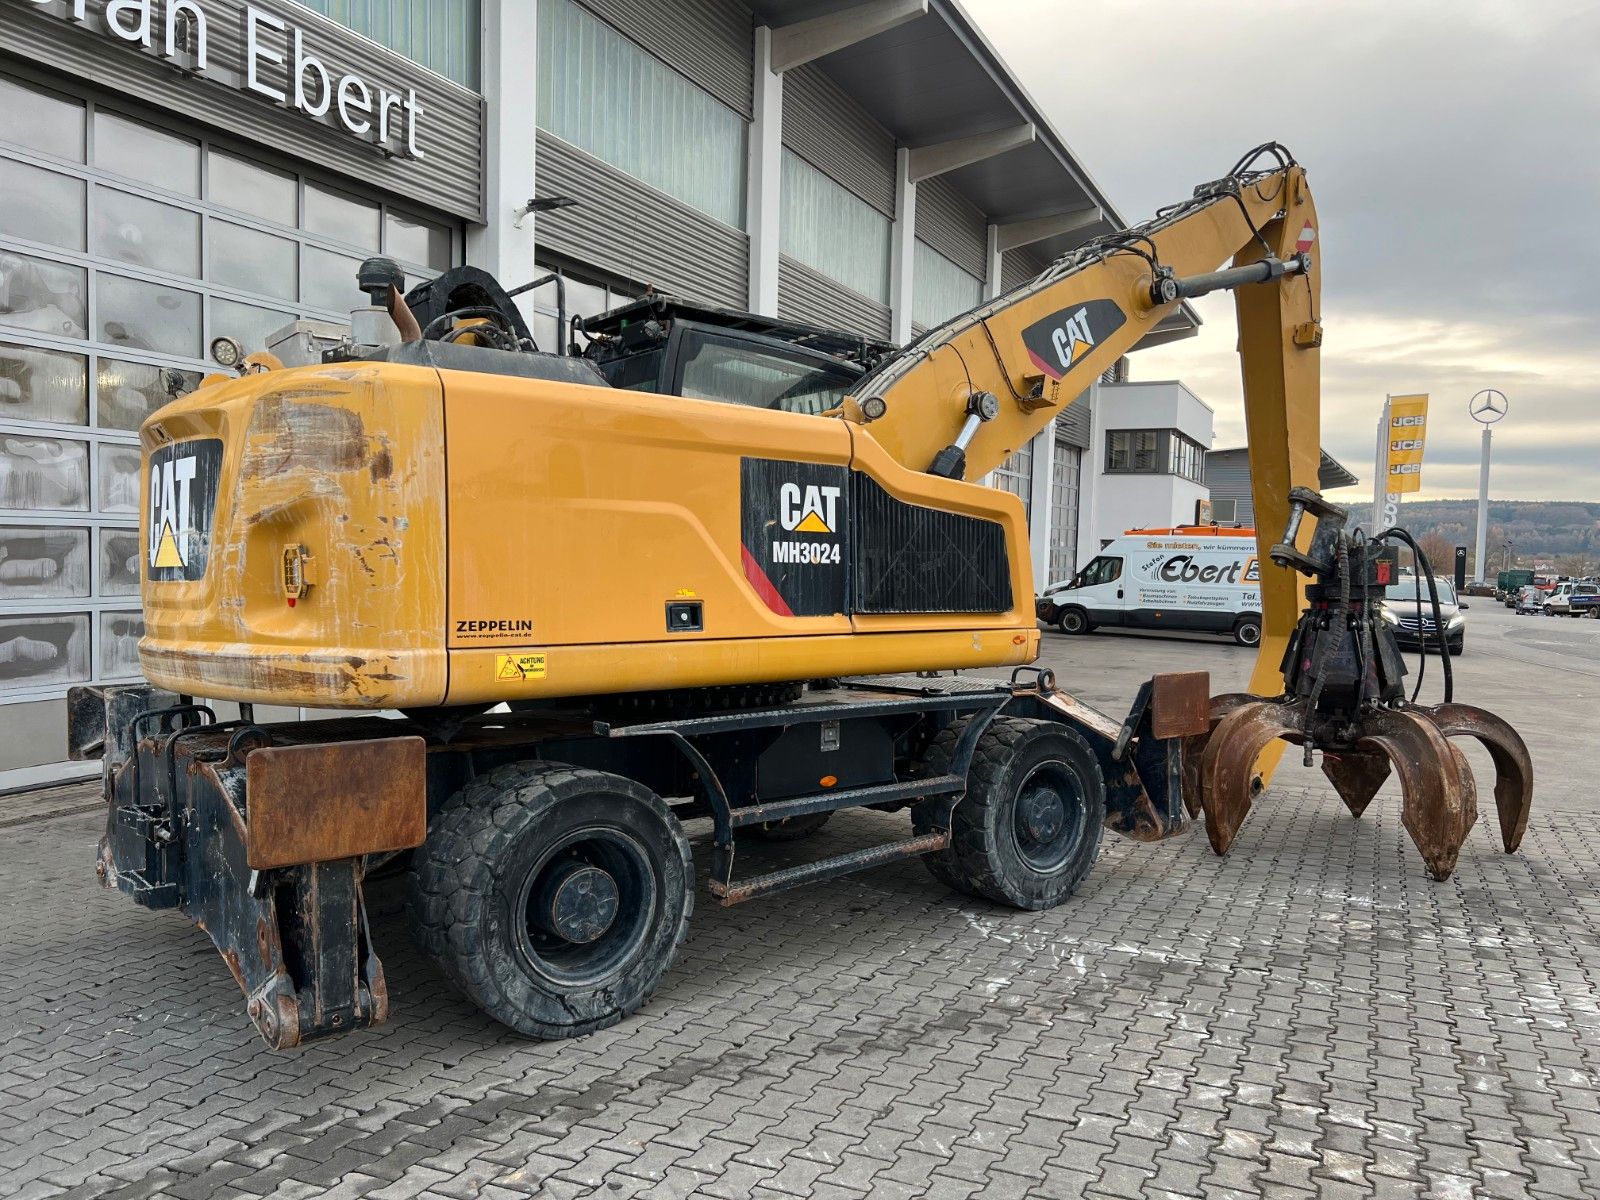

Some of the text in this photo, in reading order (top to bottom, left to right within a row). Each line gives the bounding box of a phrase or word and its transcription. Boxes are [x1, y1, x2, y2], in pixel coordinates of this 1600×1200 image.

[247, 5, 425, 158] Ebert
[1051, 307, 1095, 367] CAT
[1392, 416, 1425, 427] JCB
[1391, 440, 1424, 451] JCB
[1390, 464, 1421, 475] JCB
[150, 456, 197, 567] CAT
[780, 482, 841, 533] CAT
[773, 540, 841, 565] MH3024
[1142, 554, 1165, 572] Stefan
[1161, 554, 1241, 584] Ebert
[456, 620, 532, 632] ZEPPELIN
[520, 656, 545, 665] ACHTUNG
